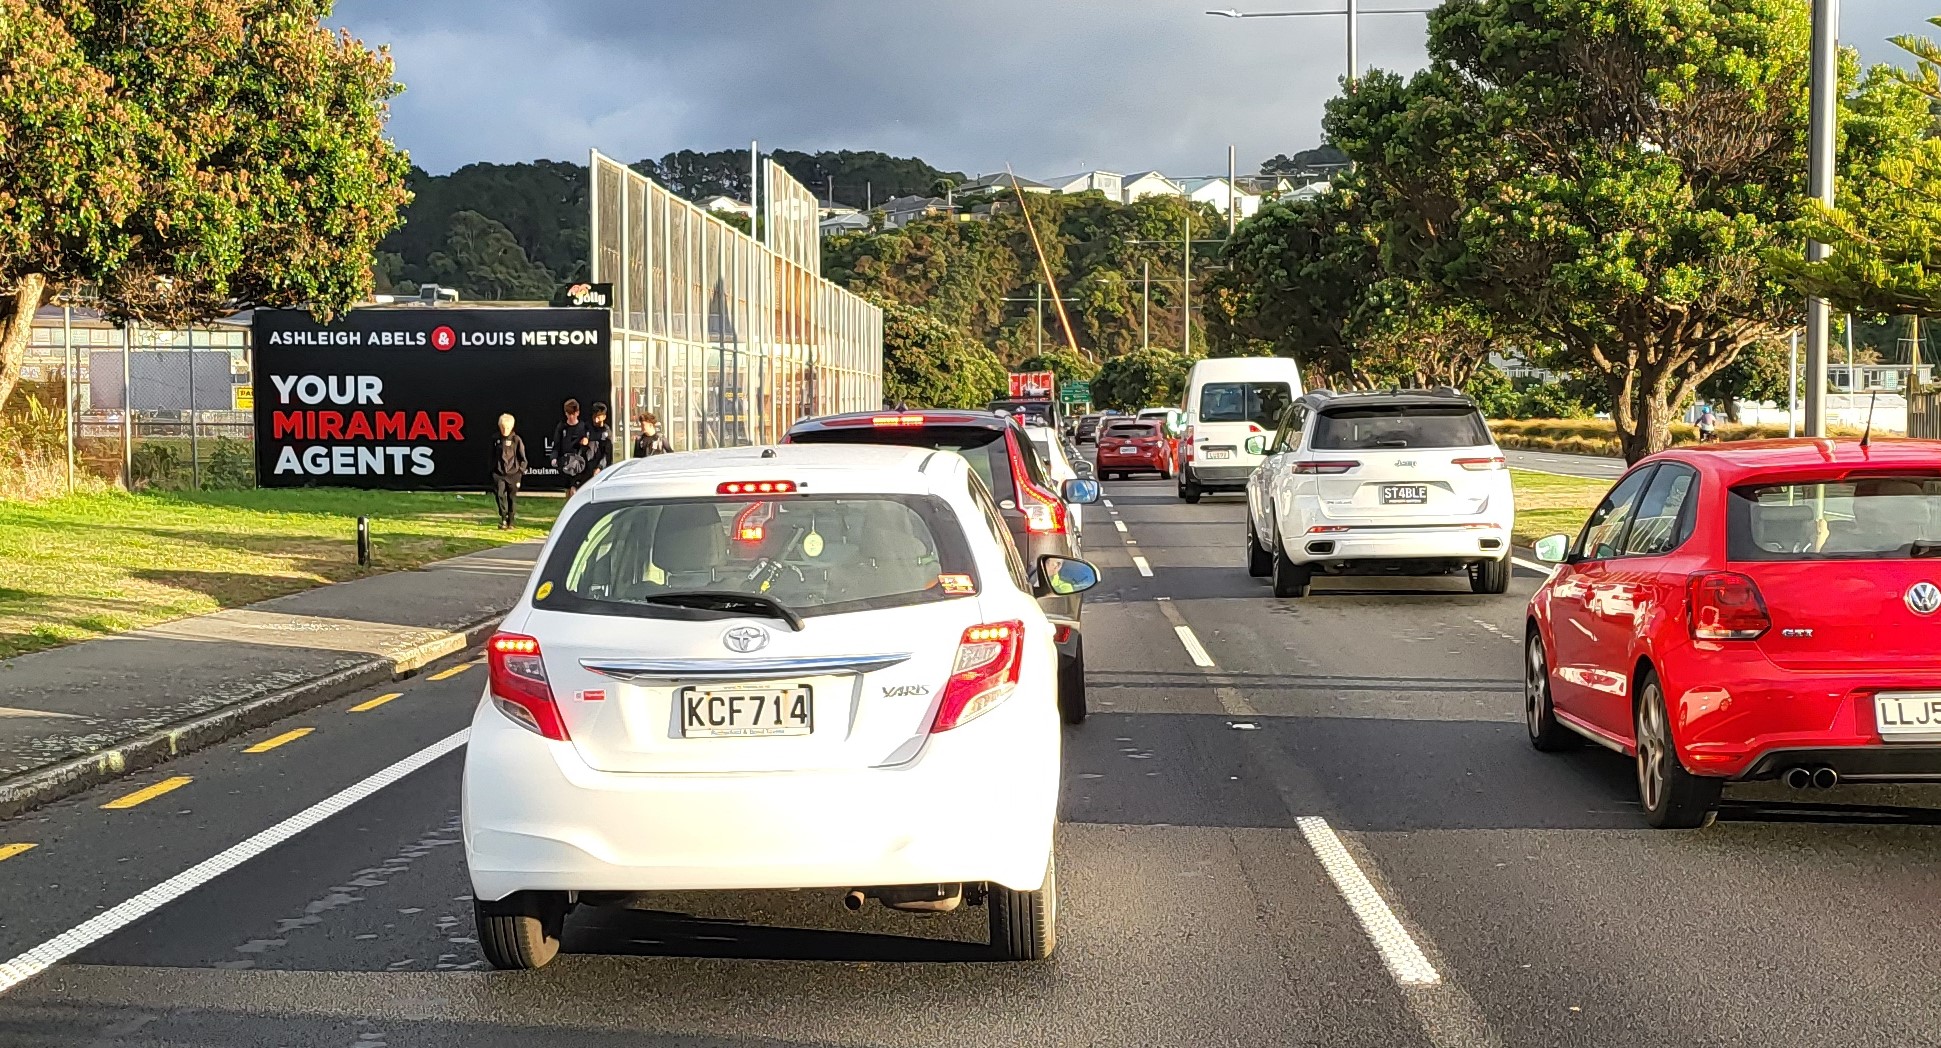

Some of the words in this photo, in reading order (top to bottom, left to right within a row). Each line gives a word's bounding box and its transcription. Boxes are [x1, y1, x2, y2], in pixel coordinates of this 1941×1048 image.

[573, 290, 606, 306] Jolly
[269, 331, 361, 345] ASHLEIGH
[367, 331, 427, 345] ABELS
[438, 331, 450, 346] &
[461, 331, 516, 346] LOUIS
[521, 329, 598, 346] METSON
[269, 374, 384, 405] YOUR
[272, 410, 465, 441] MIRAMAR
[273, 445, 436, 476] AGENTS
[1384, 487, 1427, 499] ST4BLE
[882, 684, 930, 698] YARIS
[688, 694, 808, 727] KCF714
